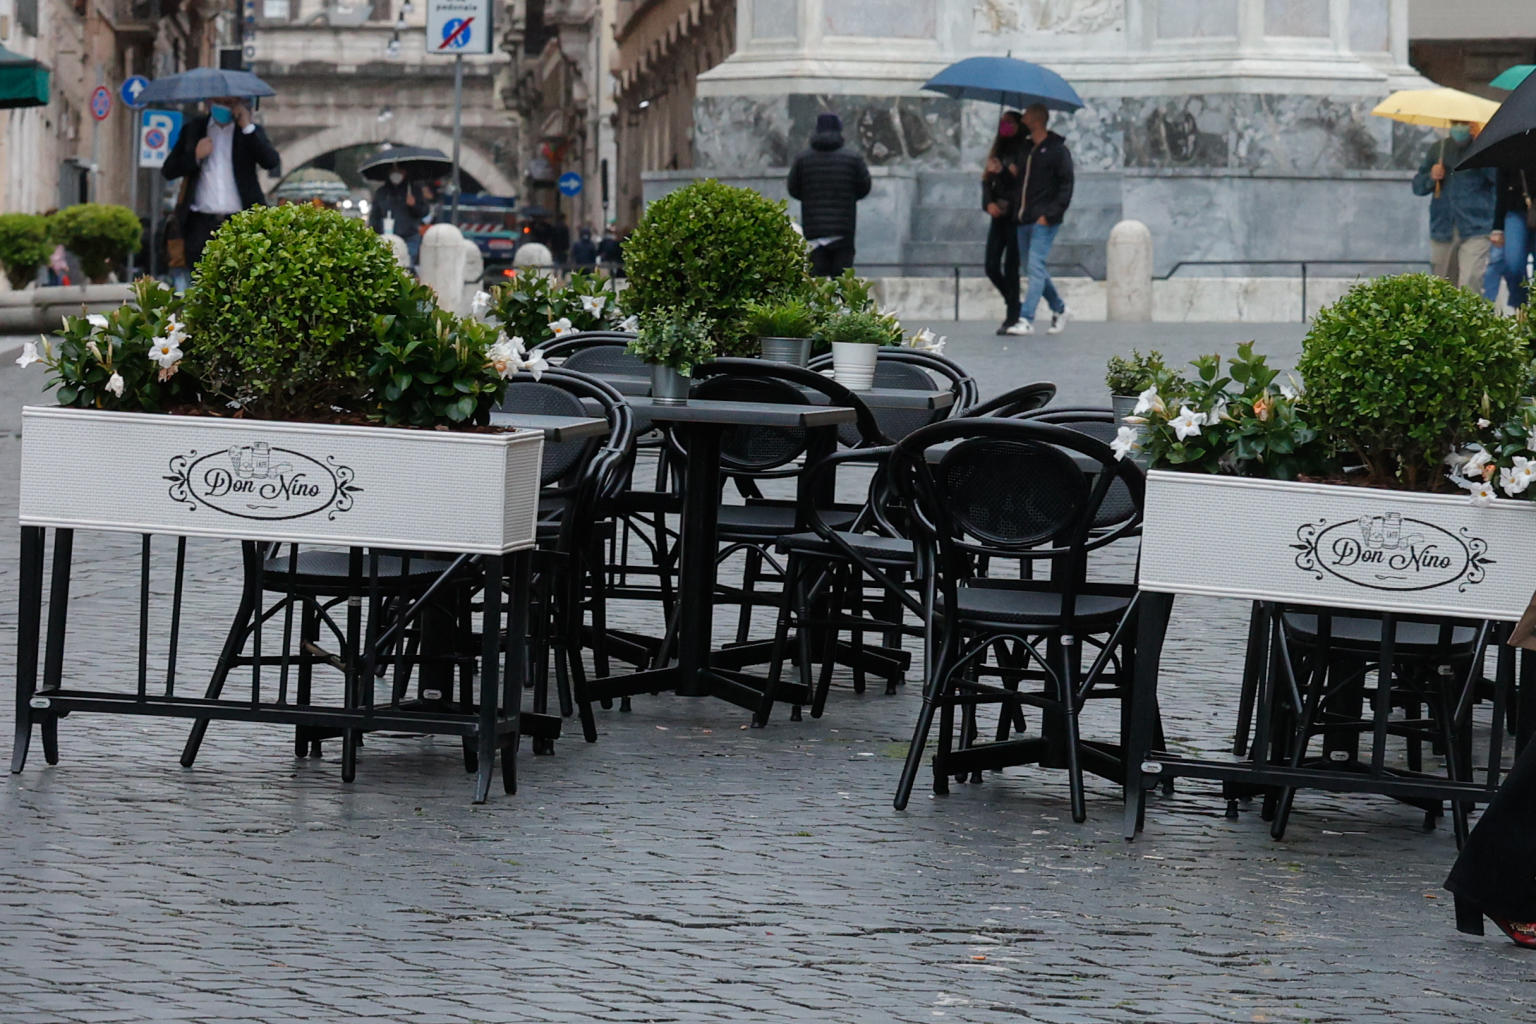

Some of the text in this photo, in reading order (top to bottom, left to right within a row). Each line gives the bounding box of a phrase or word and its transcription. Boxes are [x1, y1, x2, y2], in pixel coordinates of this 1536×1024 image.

[204, 467, 320, 501] Don Nino
[1332, 537, 1451, 571] Don Nino
